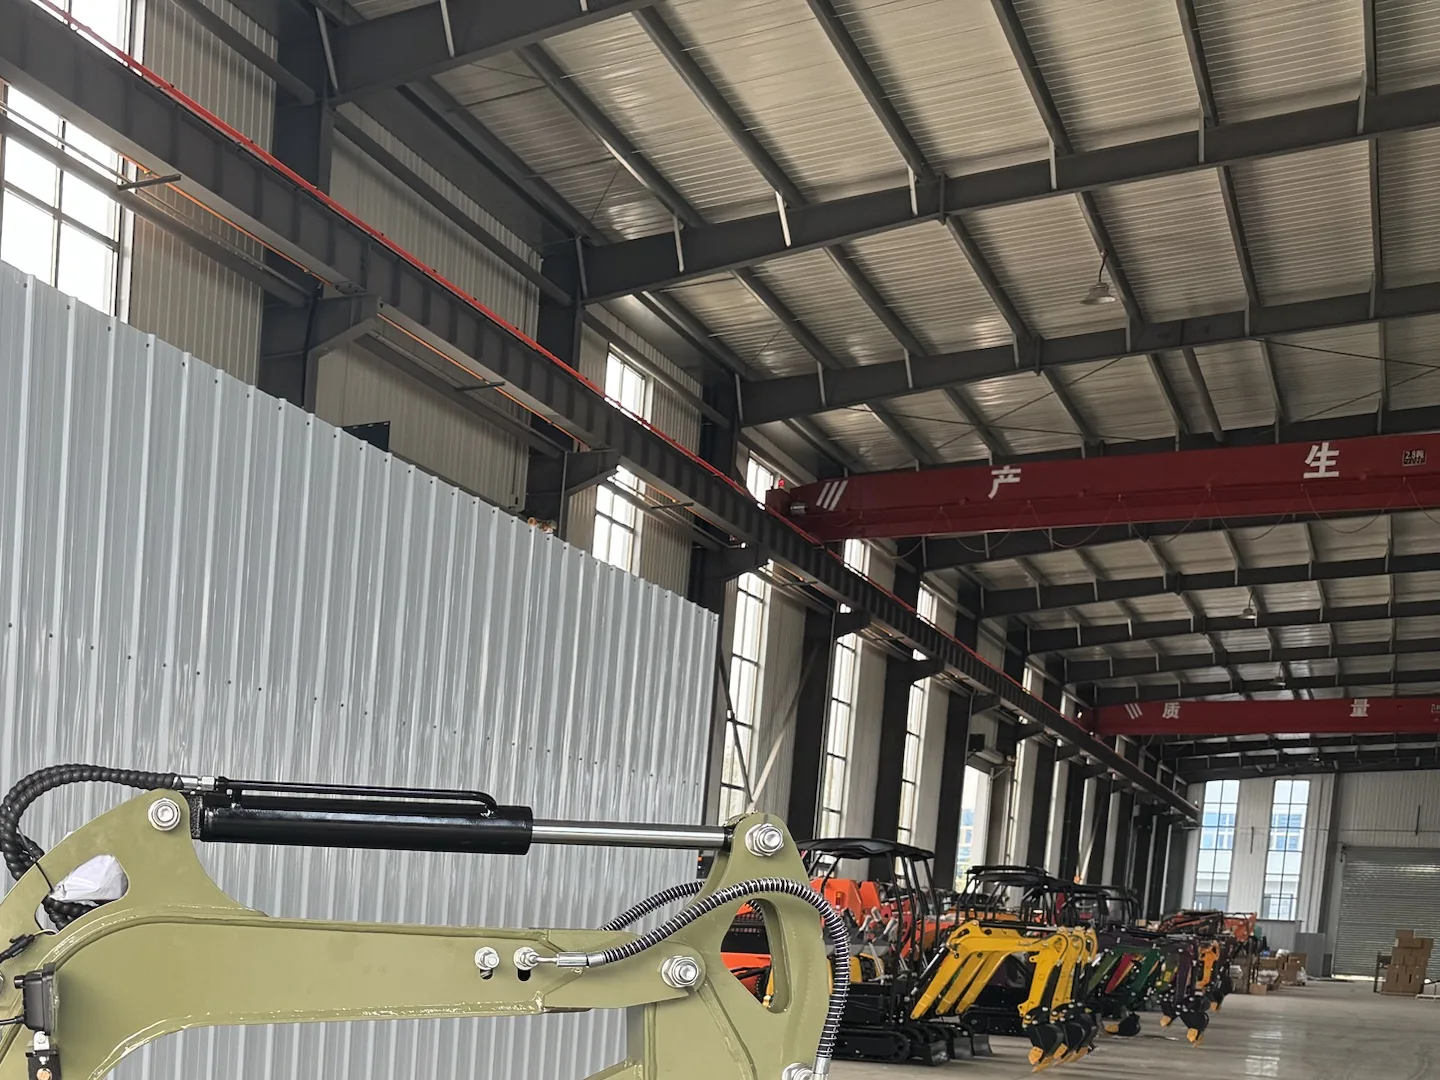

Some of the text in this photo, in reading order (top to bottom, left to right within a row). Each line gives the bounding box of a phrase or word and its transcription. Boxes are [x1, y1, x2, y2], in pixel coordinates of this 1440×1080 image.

[988, 442, 1339, 499] 产 生
[1162, 698, 1370, 719] 质 量
